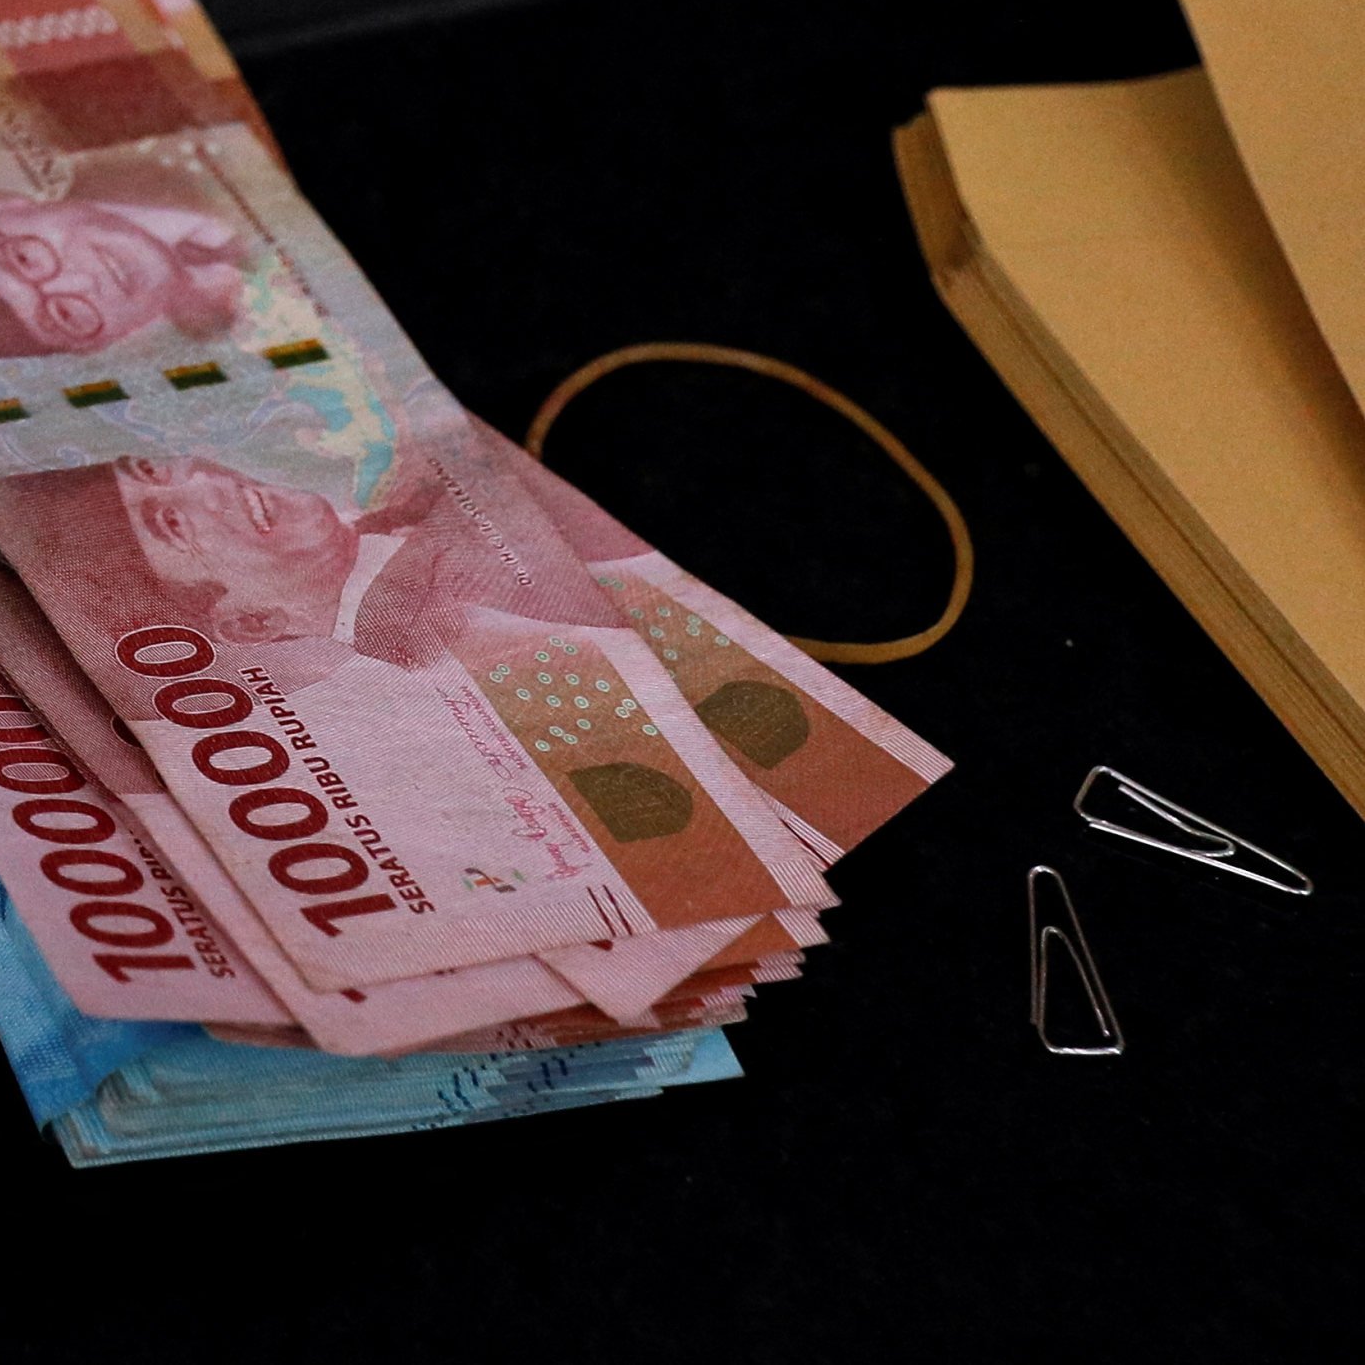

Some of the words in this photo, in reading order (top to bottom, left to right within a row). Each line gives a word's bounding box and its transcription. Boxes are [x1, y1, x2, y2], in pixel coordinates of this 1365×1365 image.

[238, 665, 318, 752] RUPIAH
[114, 624, 398, 938] 100000
[301, 755, 359, 810] RIBU
[344, 813, 436, 915] SERATUS
[160, 886, 236, 979] SERATUS
